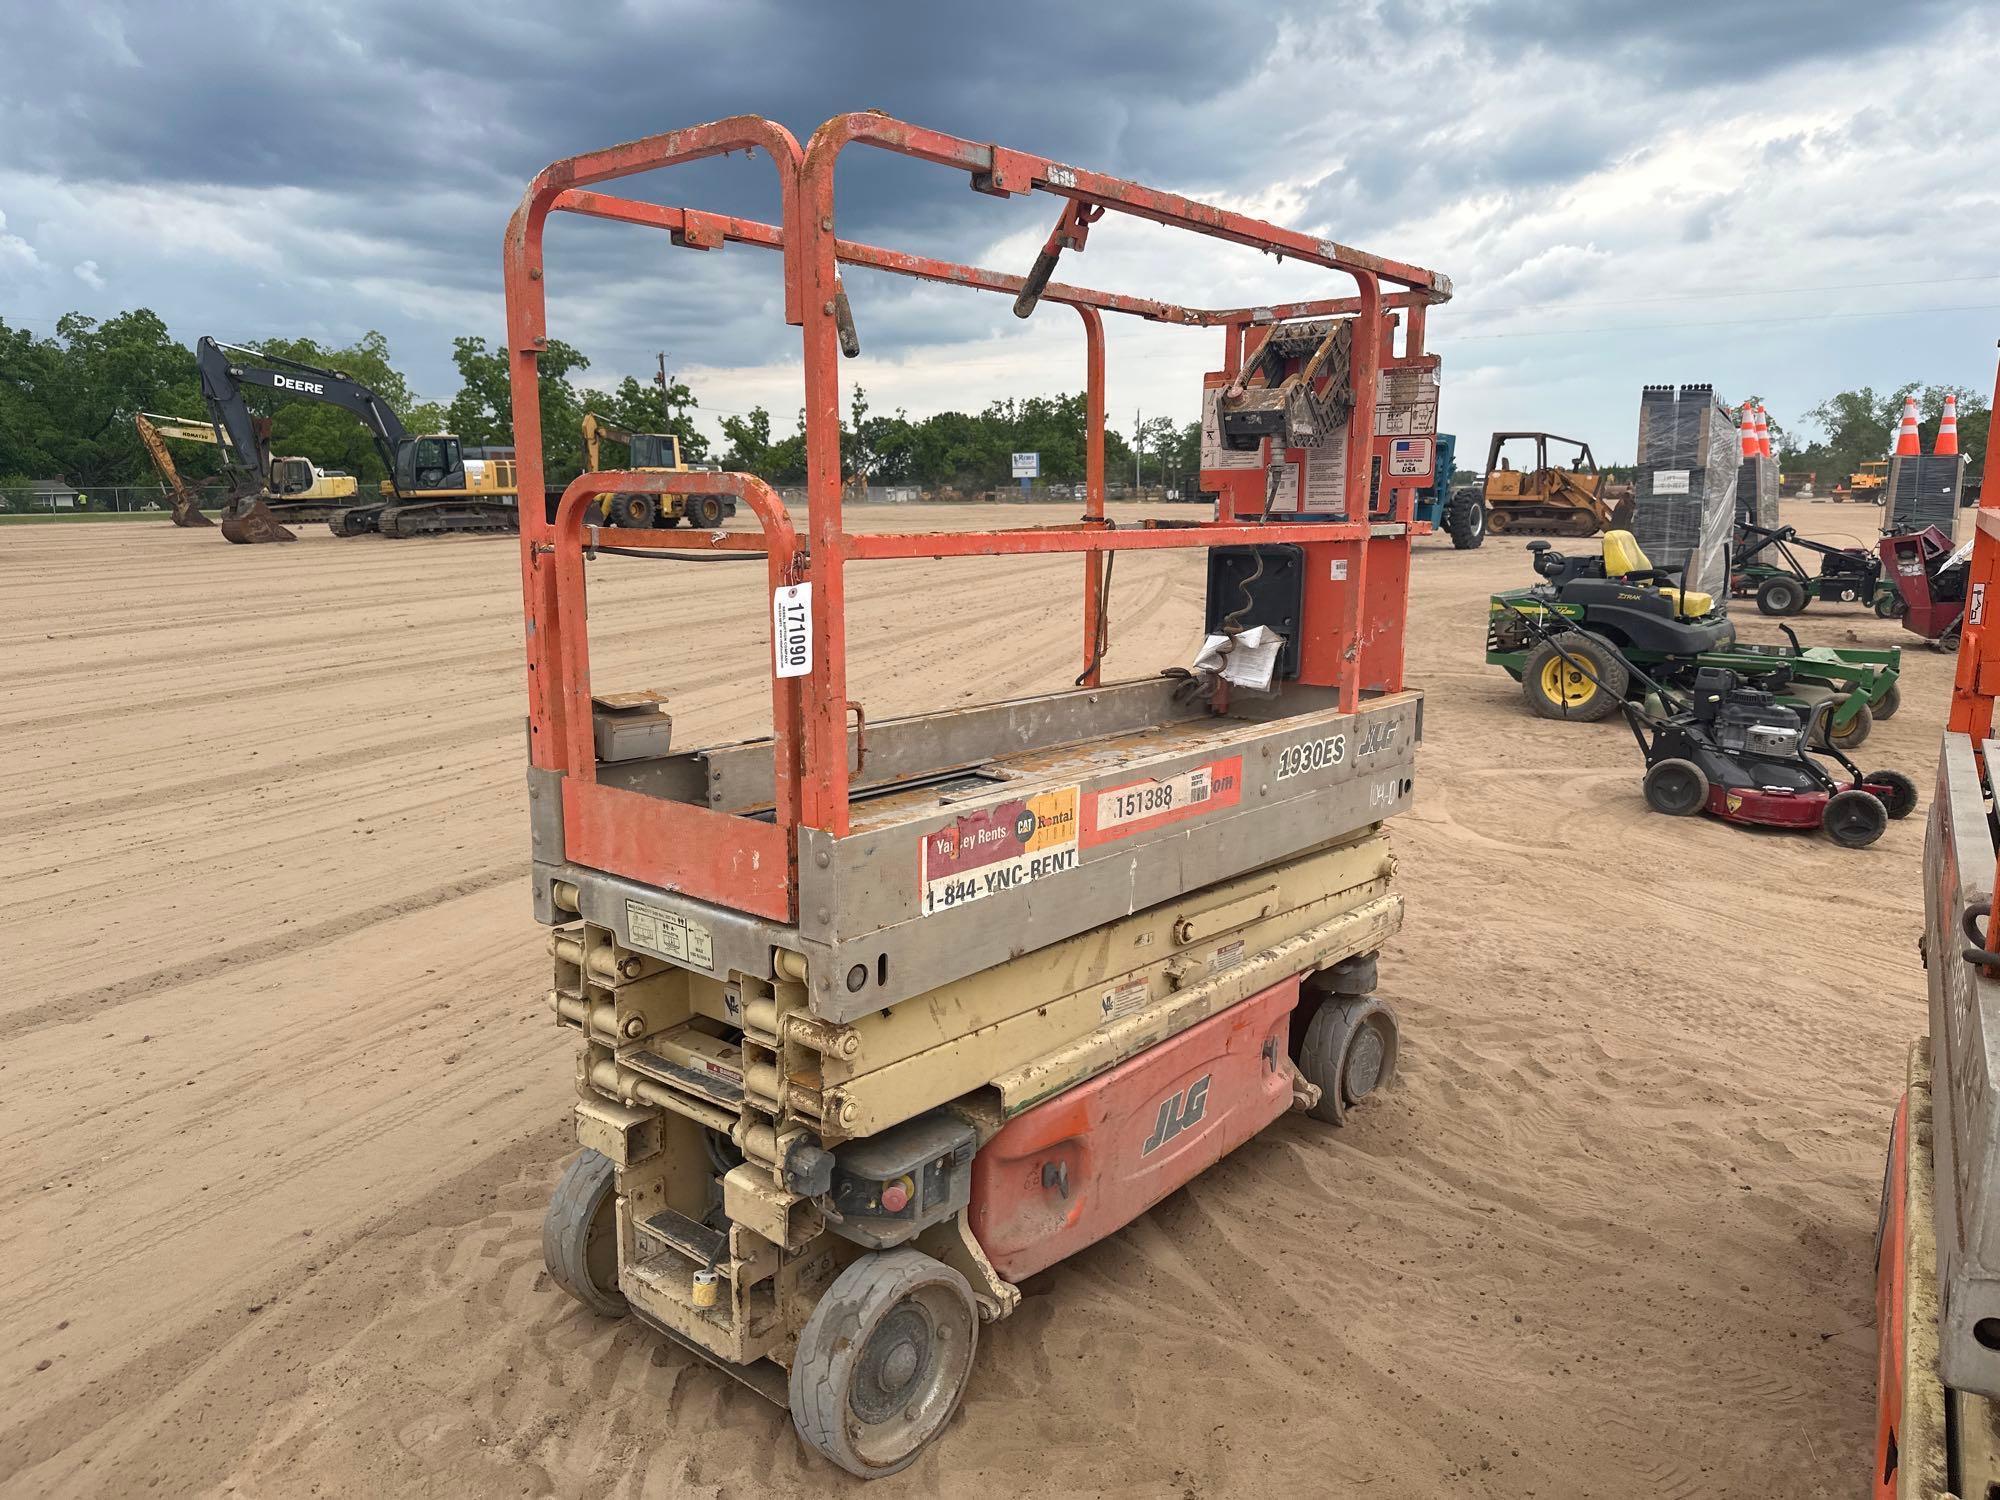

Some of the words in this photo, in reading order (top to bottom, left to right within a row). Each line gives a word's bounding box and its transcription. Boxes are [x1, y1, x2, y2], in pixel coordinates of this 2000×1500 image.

[273, 374, 324, 395] DEERE
[787, 602, 806, 666] 171090
[1277, 734, 1346, 781] 1930ES
[1116, 784, 1173, 818] 151388
[978, 826, 1007, 844] Rents
[1017, 818, 1033, 834] CAT
[926, 849, 1075, 912] 1-844-YNC-RENT
[1141, 1074, 1211, 1158] JLG
